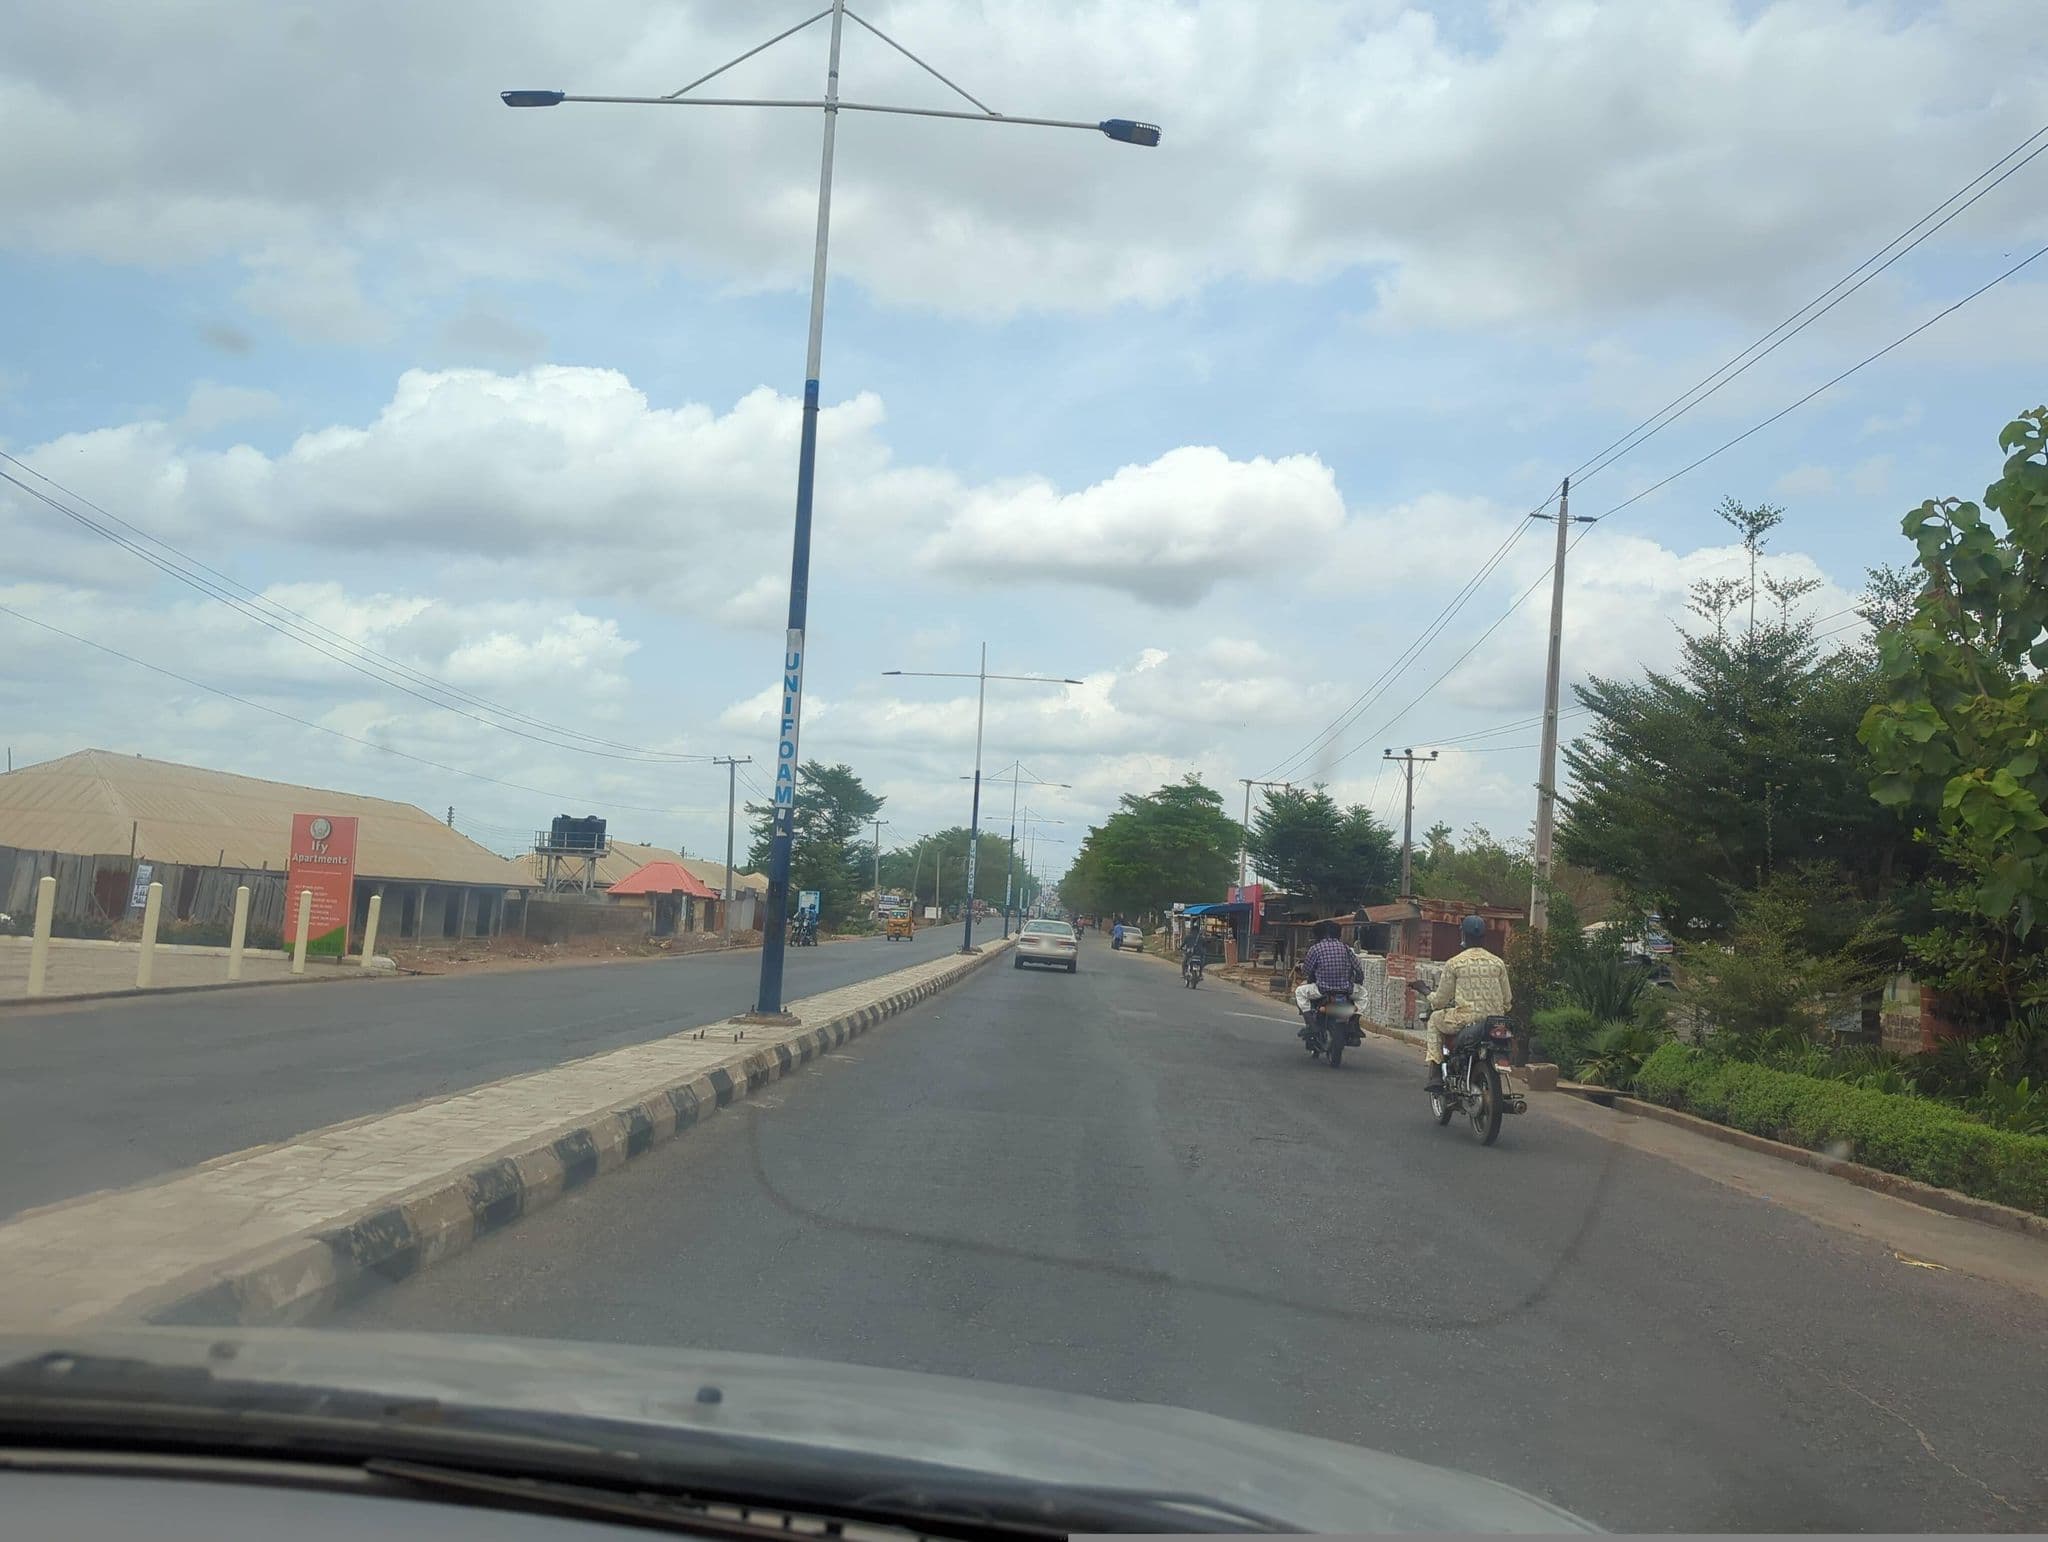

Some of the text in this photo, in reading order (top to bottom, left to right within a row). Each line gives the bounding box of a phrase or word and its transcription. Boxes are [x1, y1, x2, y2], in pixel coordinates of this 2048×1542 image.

[775, 652, 800, 804] UNIFOAM
[311, 840, 328, 854] Ify
[292, 853, 348, 865] Apartments
